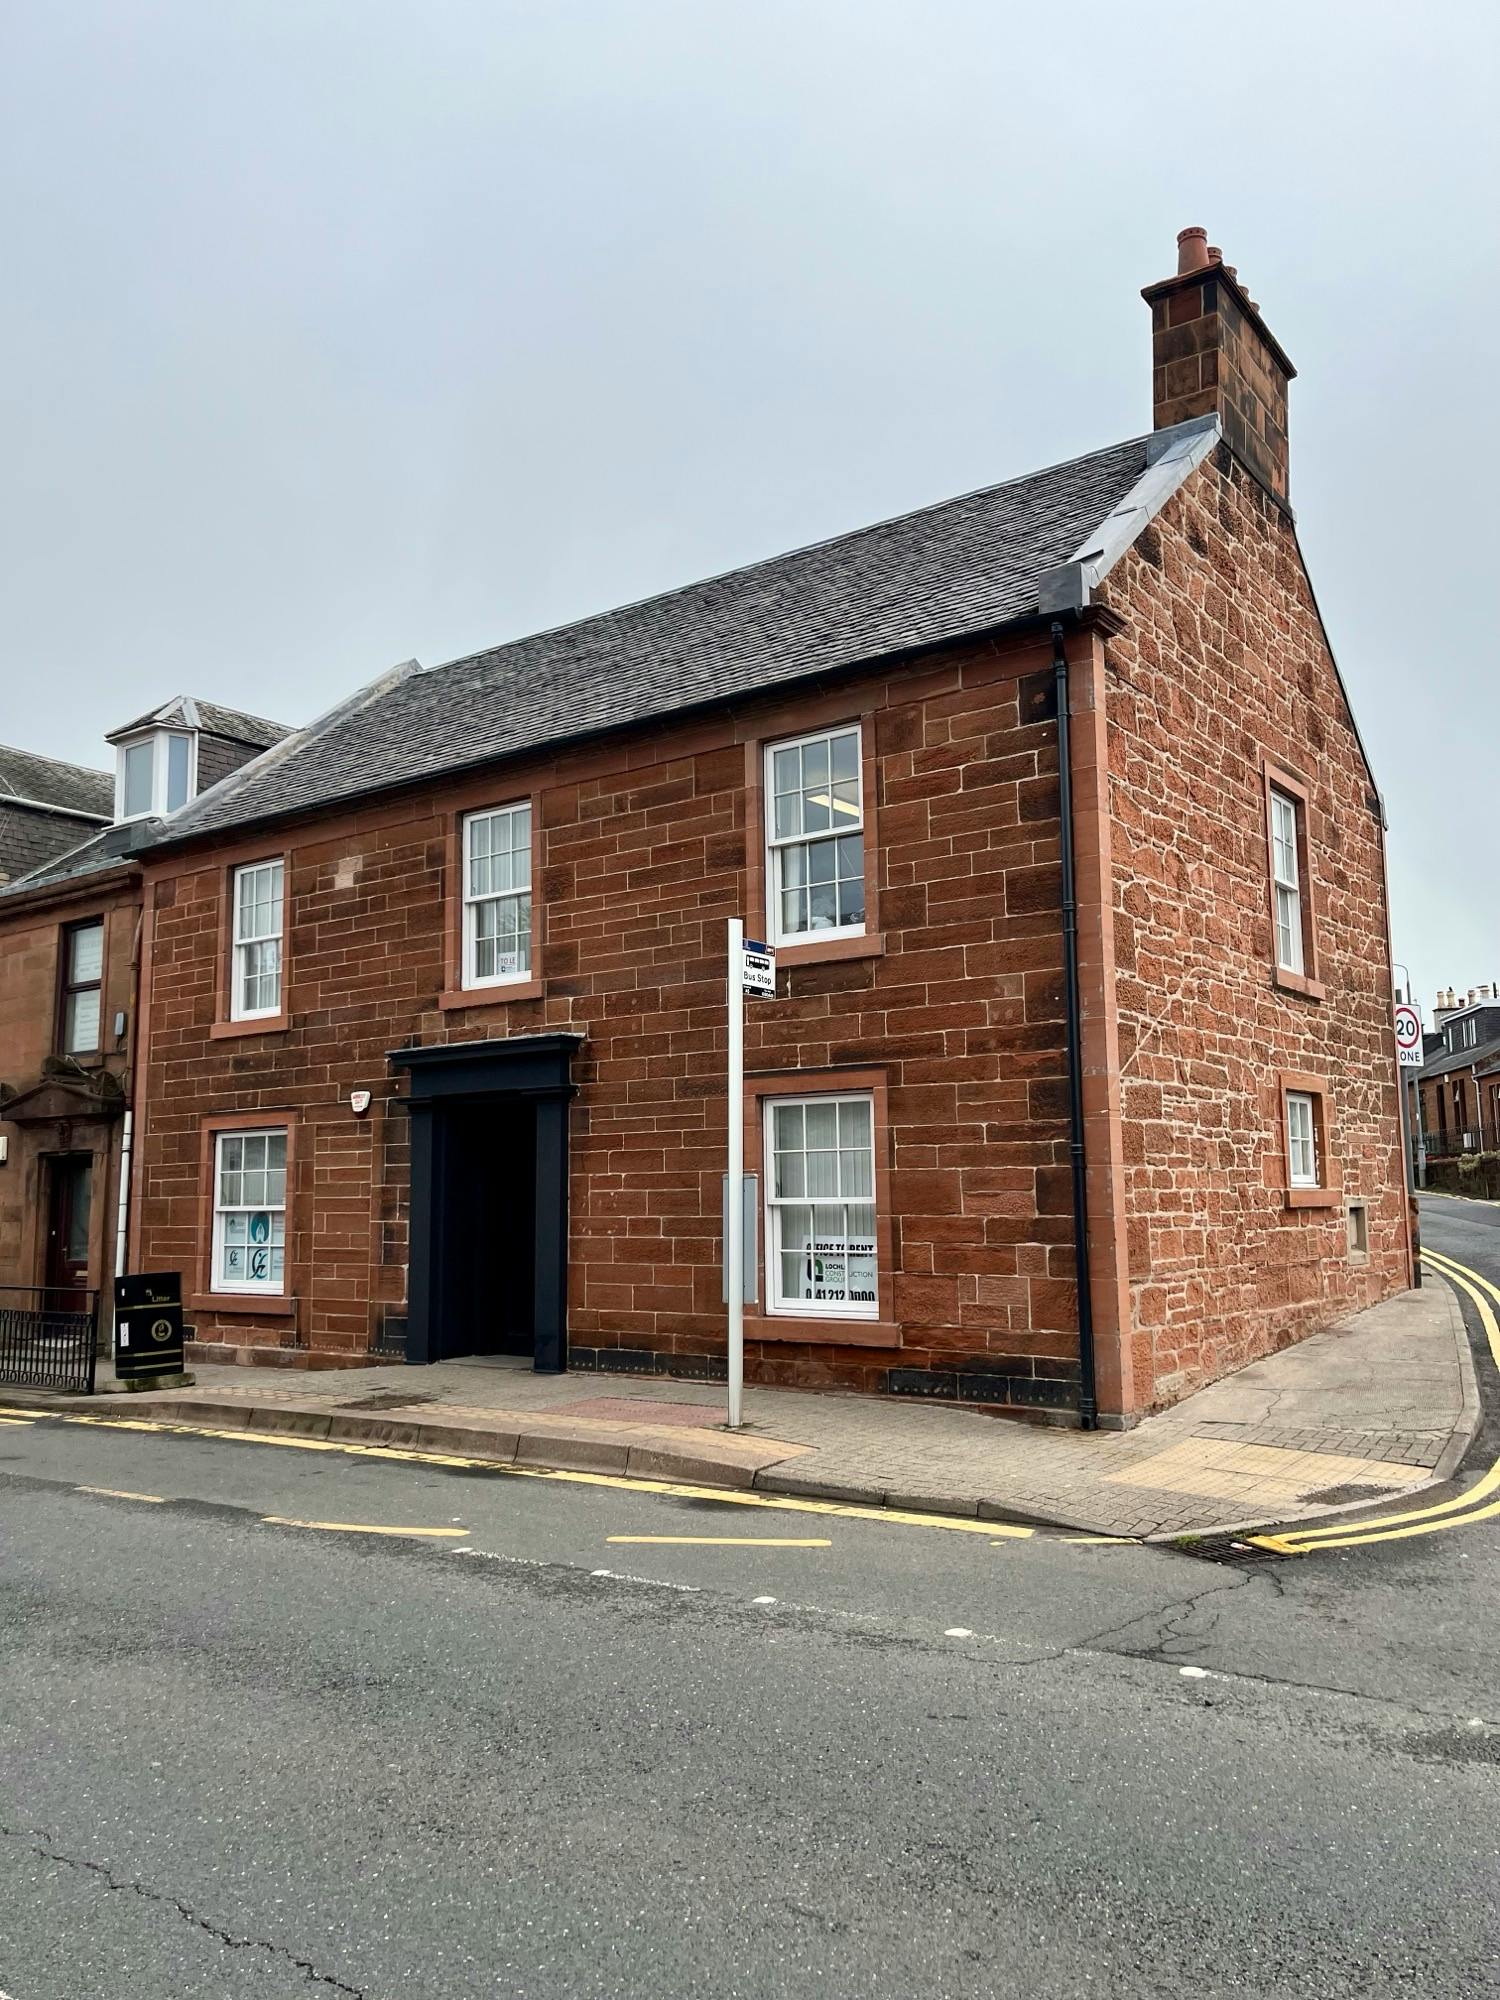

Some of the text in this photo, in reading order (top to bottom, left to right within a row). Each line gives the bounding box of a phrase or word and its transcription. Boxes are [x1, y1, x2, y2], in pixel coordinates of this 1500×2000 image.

[744, 971, 771, 985] Bus Stop
[1397, 1020, 1415, 1036] 20
[1400, 1051, 1420, 1062] ONE
[806, 1243, 834, 1257] OFICE
[849, 1245, 874, 1257] RENT
[806, 1288, 826, 1300] 041
